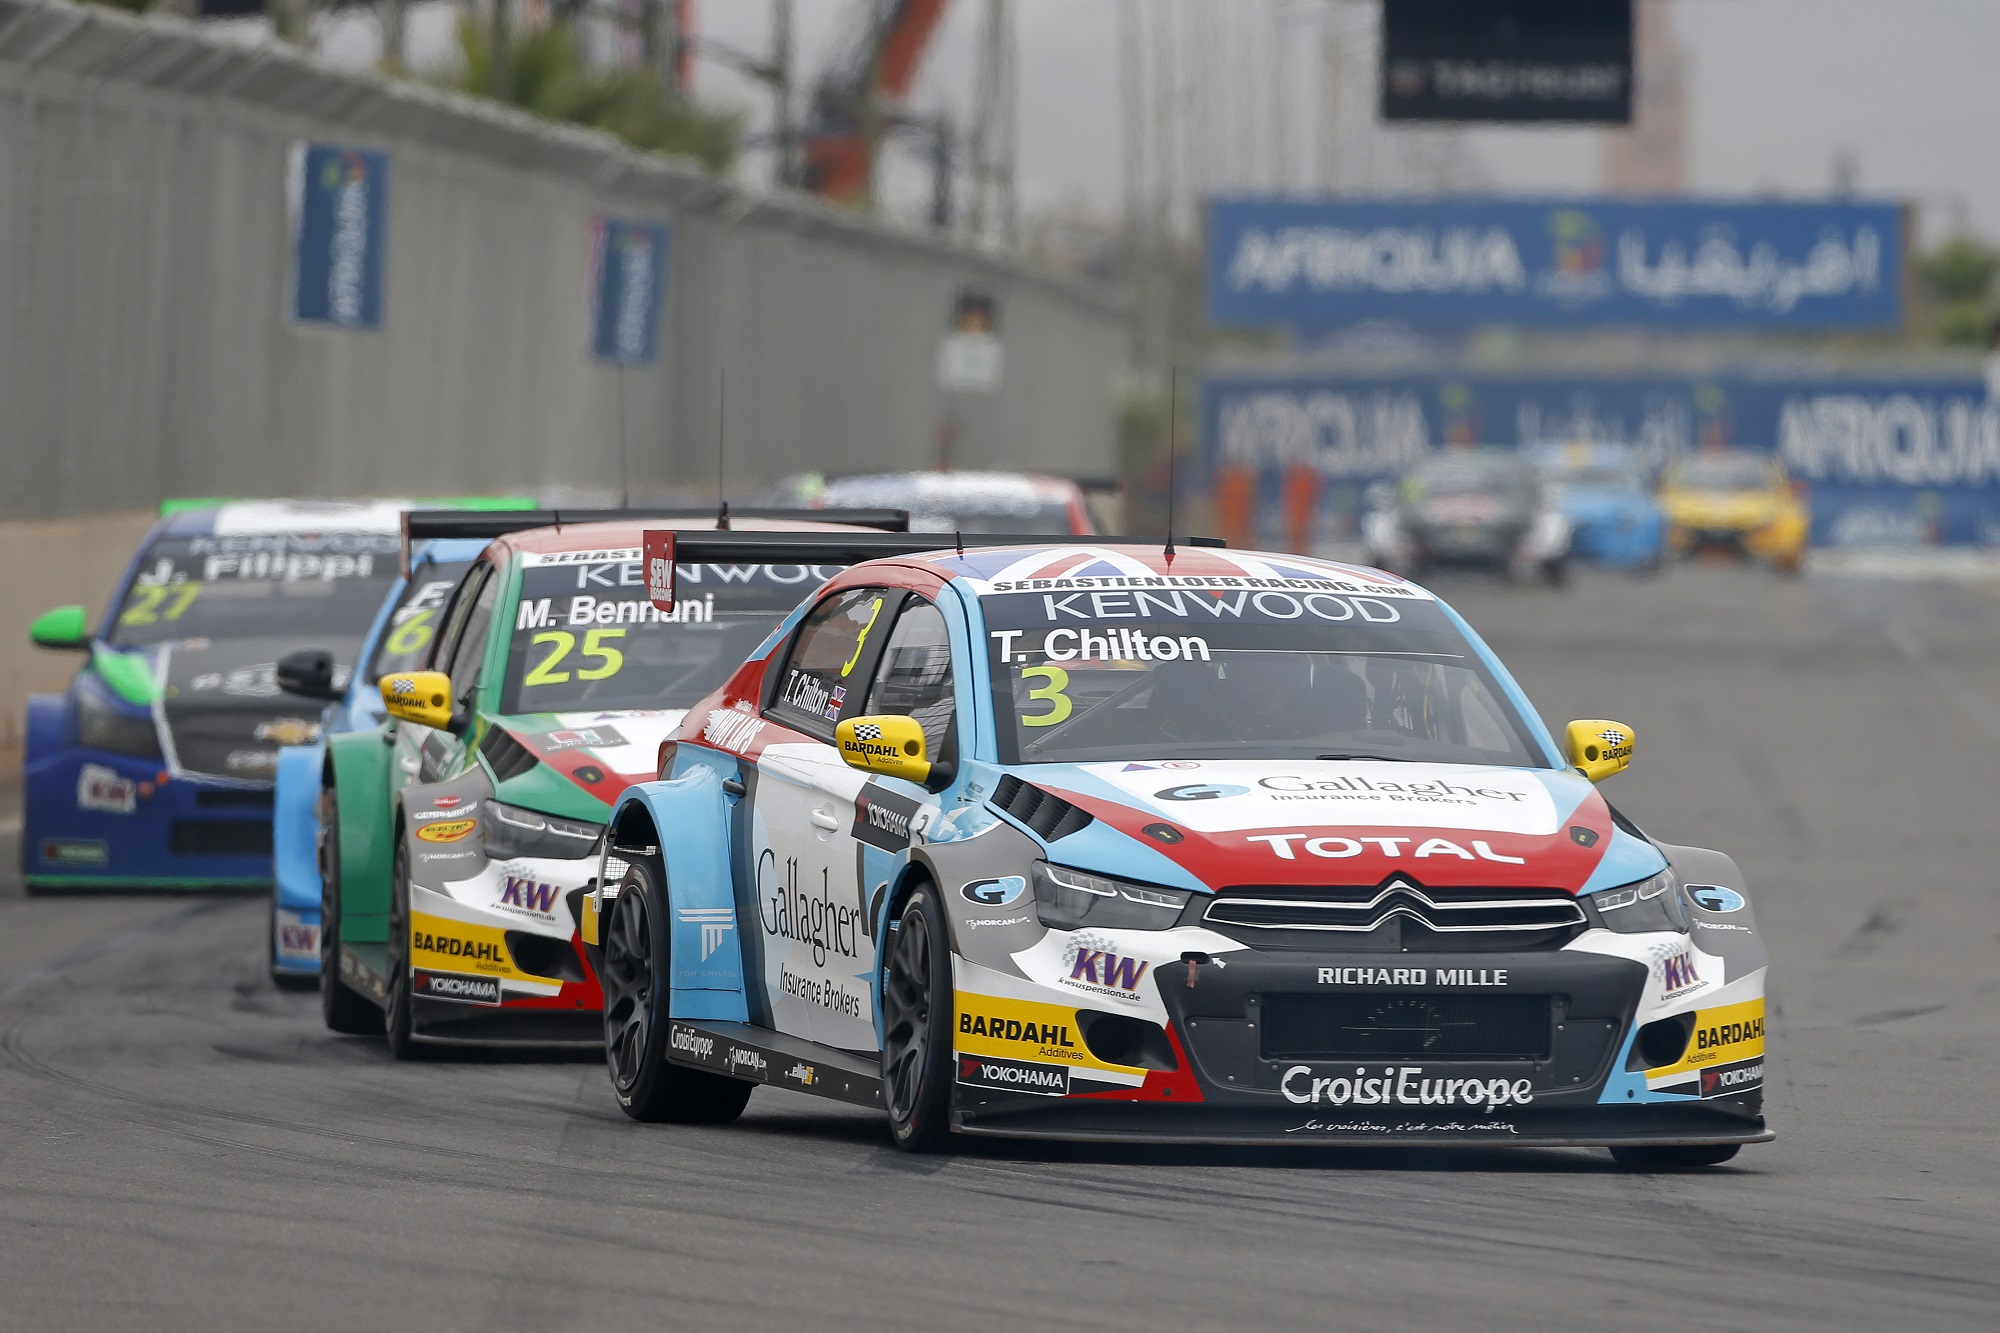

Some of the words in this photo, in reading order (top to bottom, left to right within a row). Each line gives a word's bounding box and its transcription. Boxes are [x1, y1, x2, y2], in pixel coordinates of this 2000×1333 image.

[650, 558, 673, 588] SEW
[119, 581, 202, 627] 27
[516, 598, 557, 631] M.
[569, 593, 714, 625] Bennani
[1042, 591, 1400, 624] KENWOOD
[386, 608, 437, 656] 6
[991, 629, 1027, 663] T.
[1043, 628, 1211, 662] Chilton
[525, 628, 627, 686] 25
[792, 672, 830, 716] Chilton
[1021, 666, 1073, 727] 3
[844, 740, 899, 757] BARDAHL
[1257, 775, 1527, 802] Gallagher
[867, 802, 909, 839] YOKOHAMA
[1246, 832, 1526, 865] TOTAL
[500, 876, 562, 913] KW
[757, 848, 860, 968] Gallagher
[413, 931, 504, 962] BARDAHL
[429, 976, 497, 998] YOKOHAMA
[1070, 947, 1149, 992] KW
[1317, 967, 1427, 985] RICHARD
[1435, 969, 1508, 986] MILLE
[779, 962, 822, 1004] Insurance
[823, 979, 860, 1018] Brokers
[1058, 977, 1142, 1002] kwsuspensions.de
[670, 1024, 714, 1061] CroisiEurope
[959, 1012, 1075, 1048] BARDAHL
[1038, 1046, 1084, 1061] Additives
[1686, 1051, 1717, 1065] Additives
[980, 1063, 1064, 1088] YOKOHAMA
[1281, 1065, 1534, 1114] CroisiEurope
